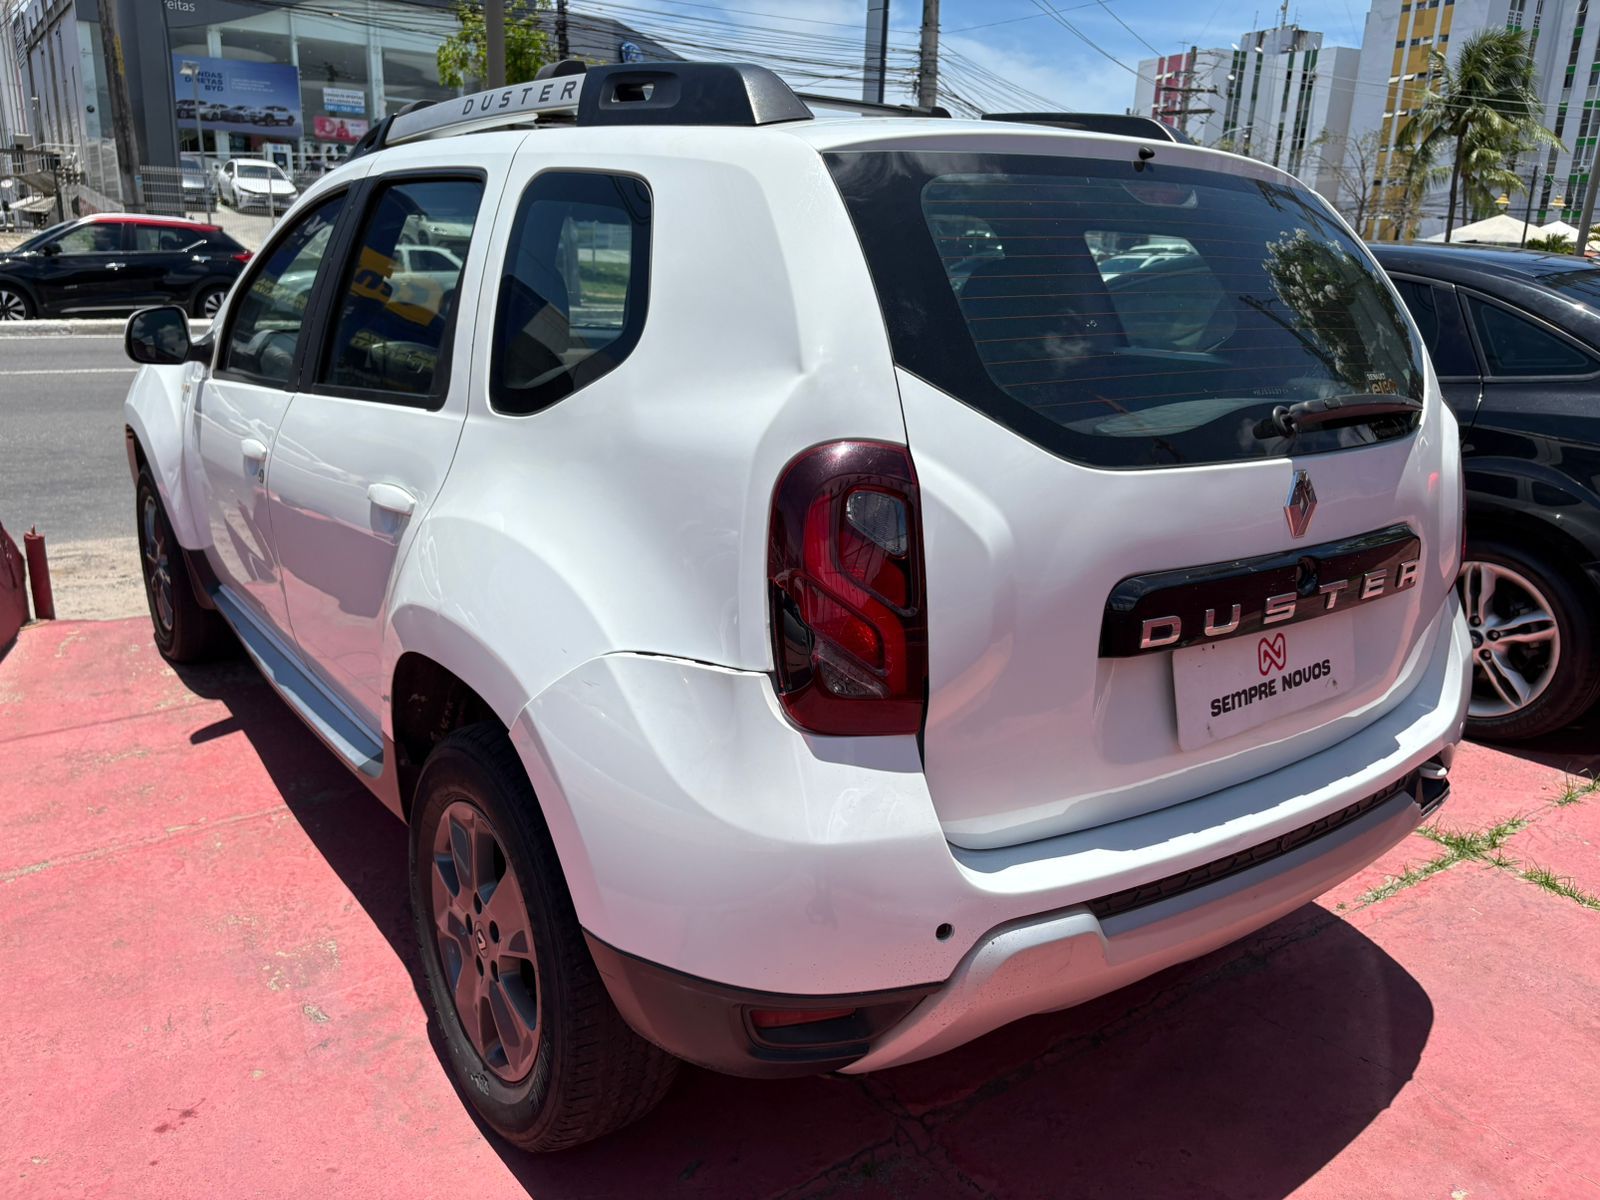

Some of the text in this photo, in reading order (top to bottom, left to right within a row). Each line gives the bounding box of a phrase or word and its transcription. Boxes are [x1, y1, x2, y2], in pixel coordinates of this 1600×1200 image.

[462, 81, 577, 115] DUSTER
[1139, 559, 1420, 649] DUSTER
[1210, 678, 1277, 717] SEMPRE
